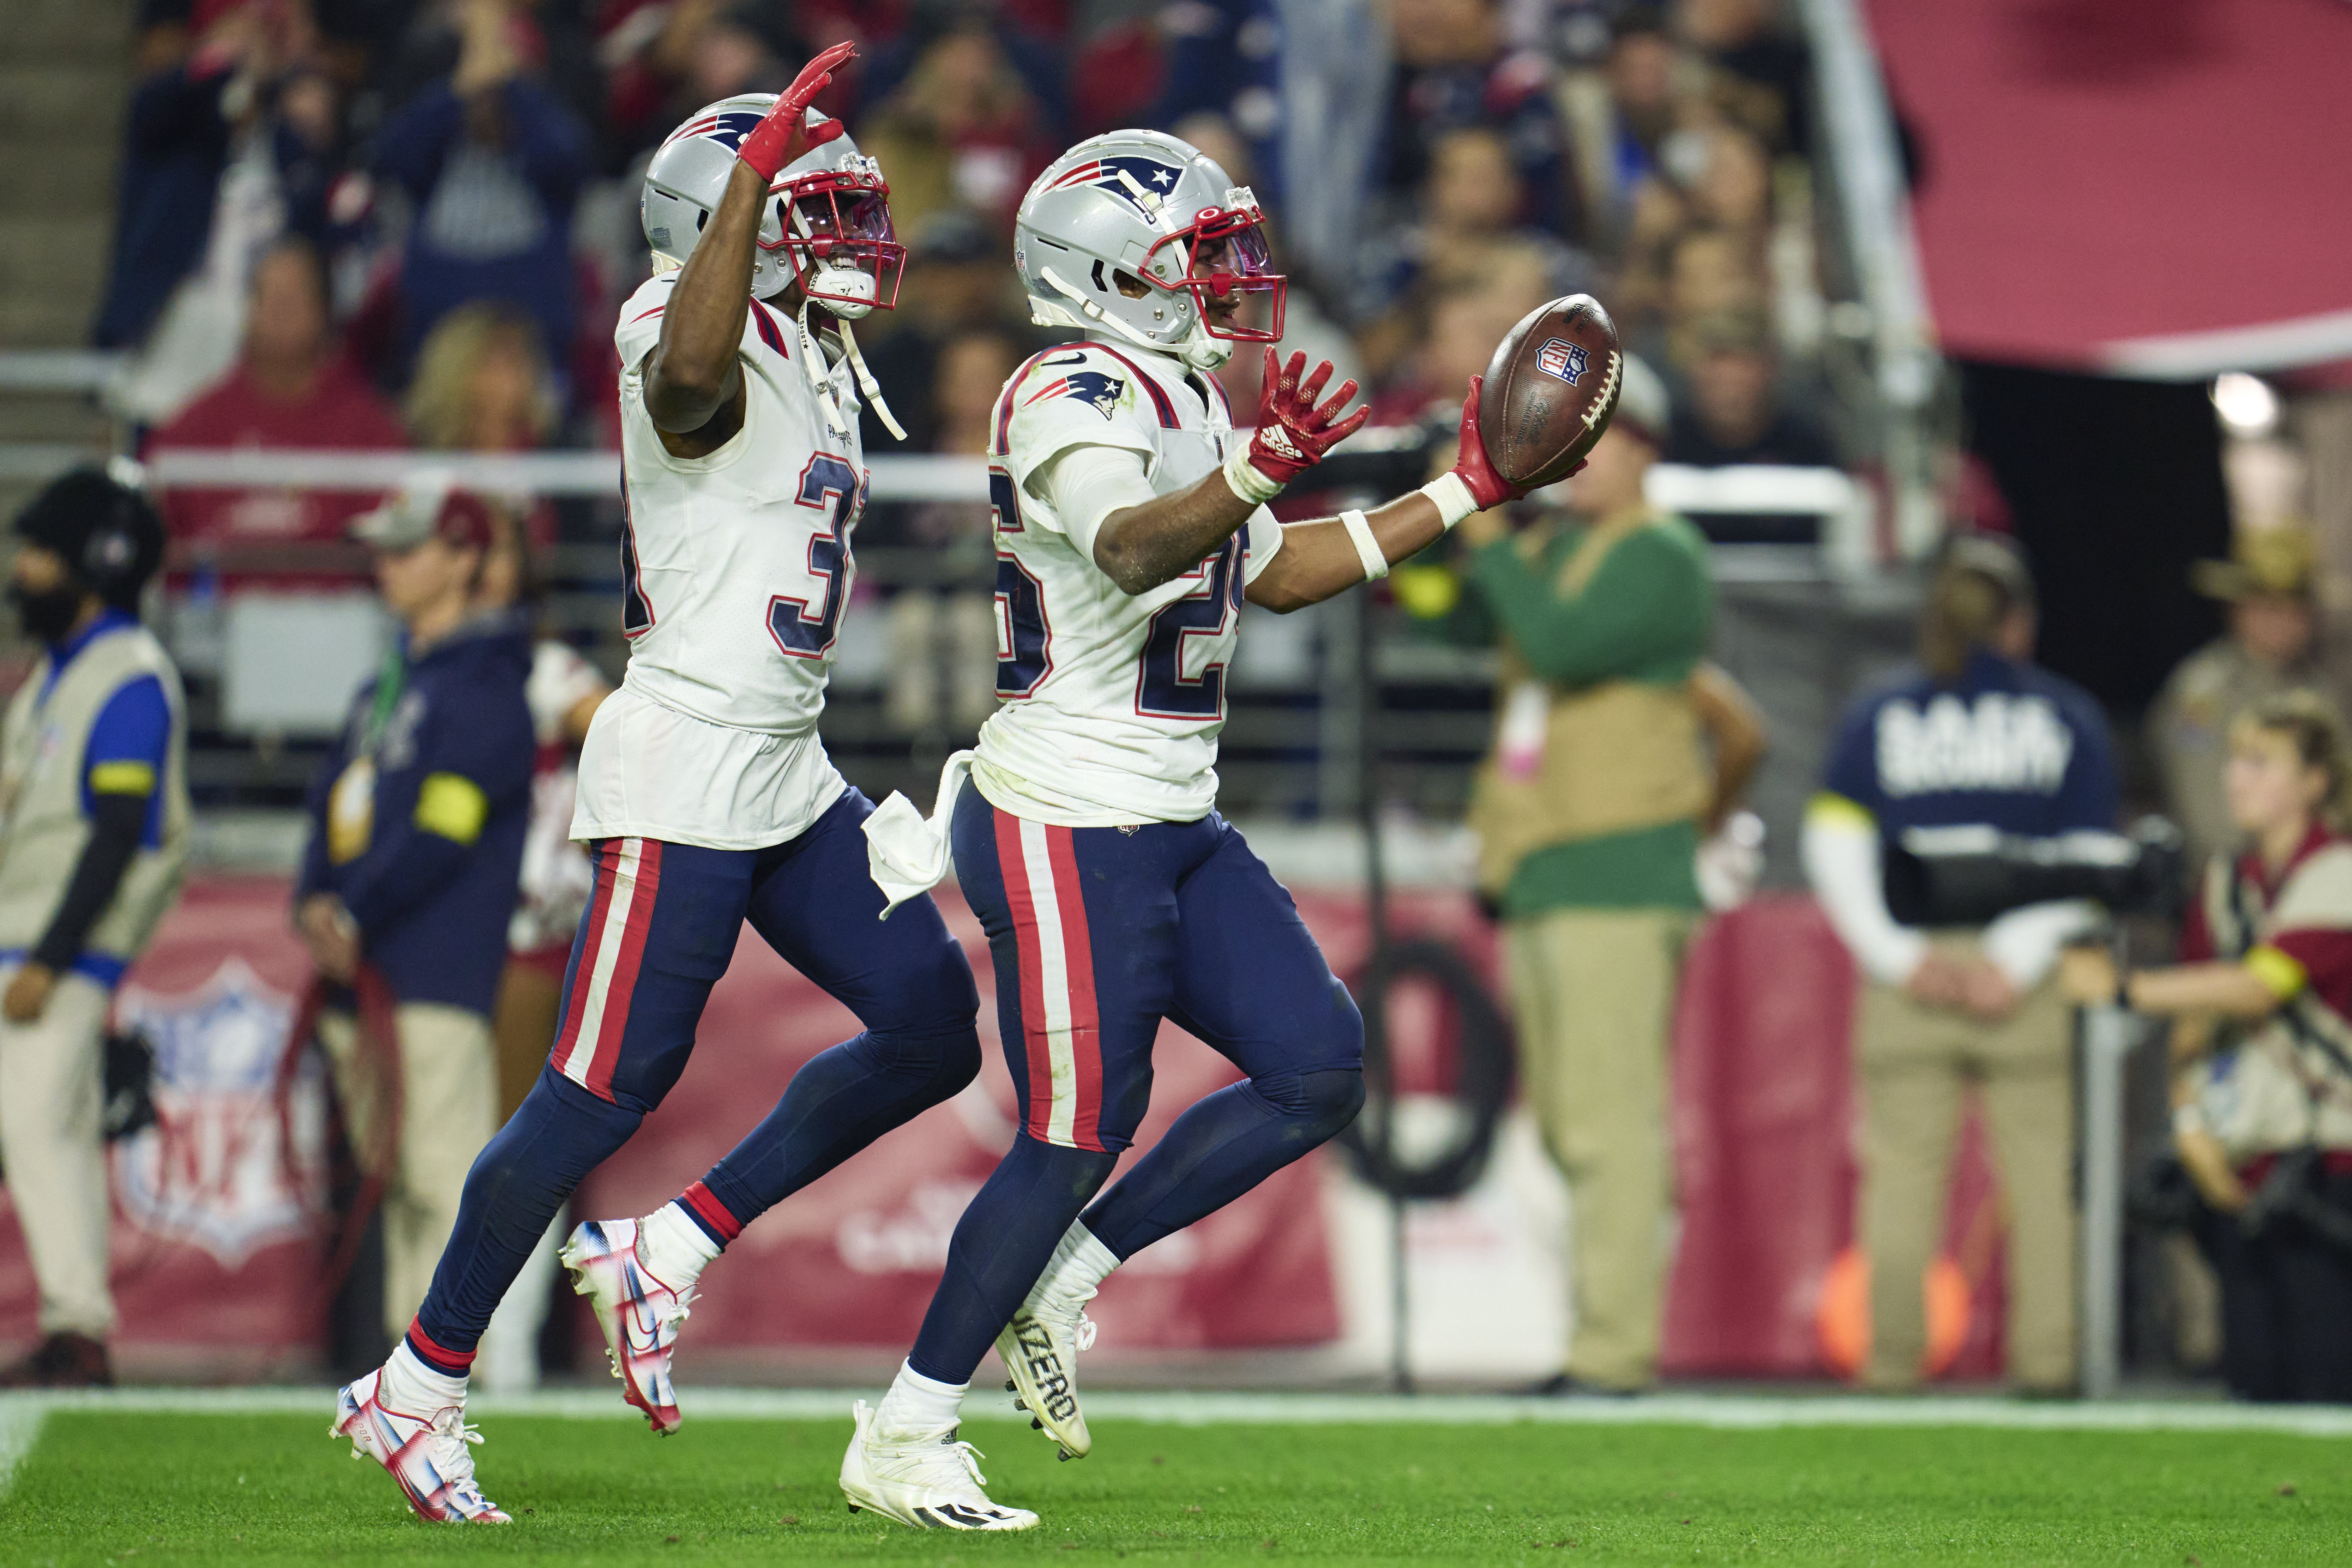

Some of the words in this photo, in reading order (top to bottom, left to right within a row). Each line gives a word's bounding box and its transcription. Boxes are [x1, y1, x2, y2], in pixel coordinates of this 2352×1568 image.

[1542, 341, 1571, 370] NFL
[1260, 433, 1303, 458] adidas
[766, 451, 870, 661] 3
